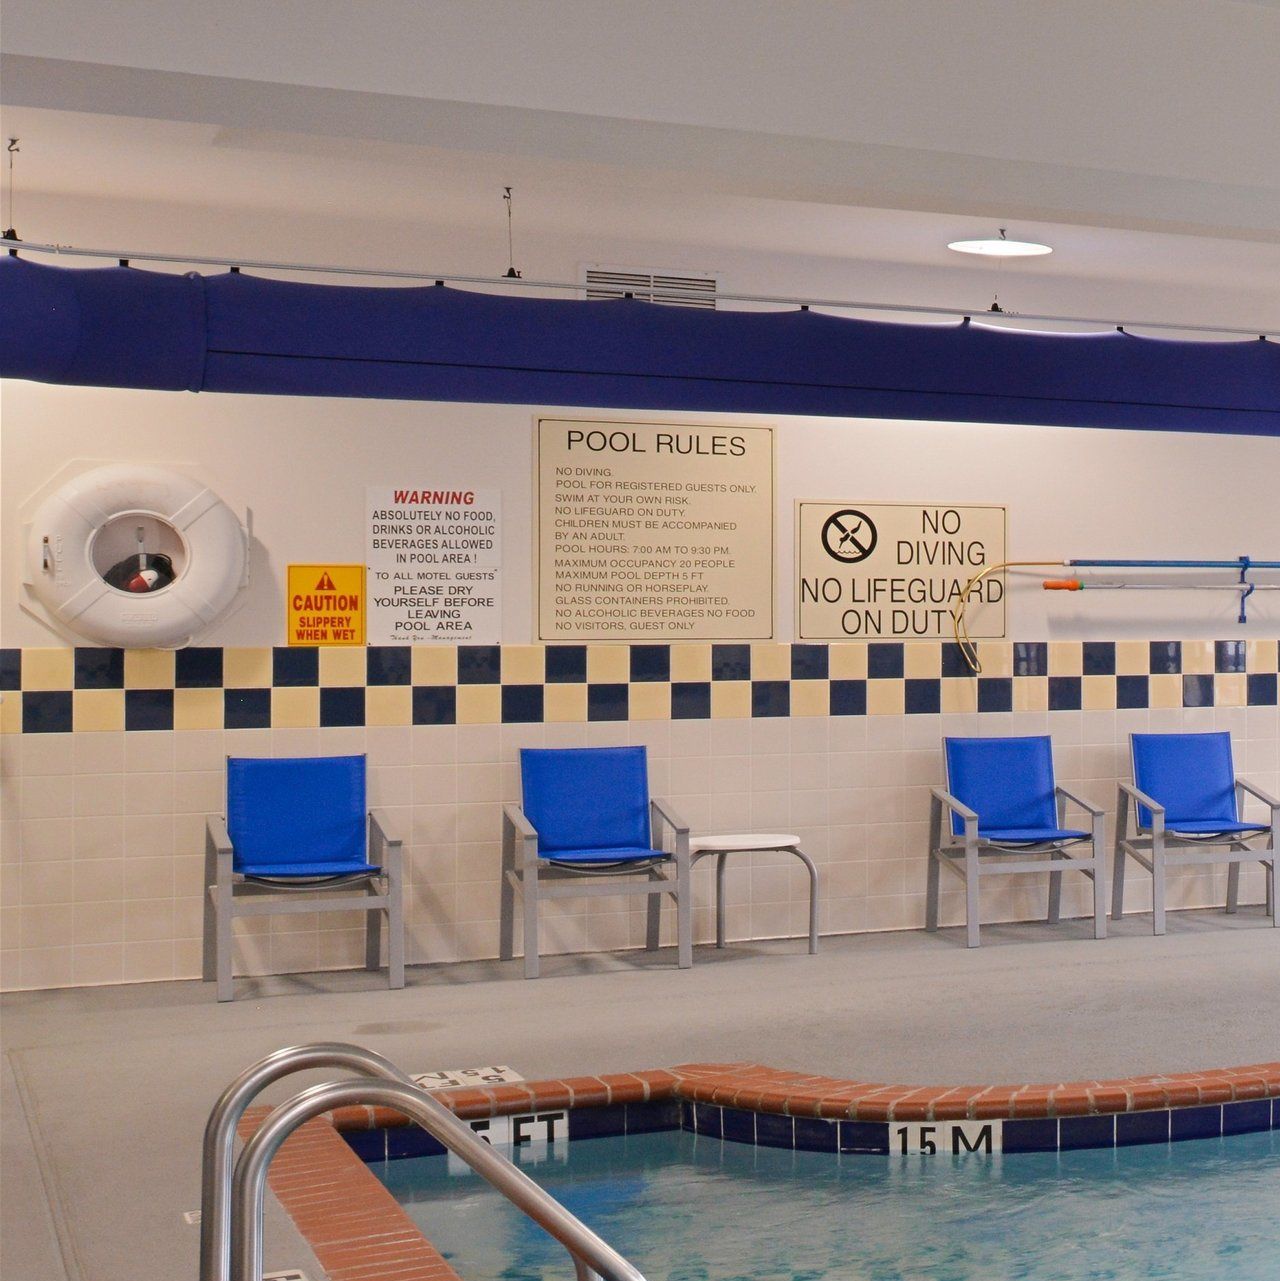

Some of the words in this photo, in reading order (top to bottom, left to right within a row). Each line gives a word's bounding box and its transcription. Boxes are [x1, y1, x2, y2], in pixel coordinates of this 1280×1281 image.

[568, 431, 646, 452] POOL
[656, 434, 745, 456] RULES
[556, 480, 586, 488] POOL
[590, 481, 611, 489] FOR
[616, 482, 682, 491] REGISTERED
[686, 484, 727, 492] GUESTS
[394, 491, 474, 504] WARNING
[555, 494, 584, 502] SWIM
[603, 495, 633, 503] YOUR
[636, 496, 662, 504] OWN
[373, 510, 441, 520] ABSOLUTELY
[446, 511, 460, 520] NO
[575, 507, 634, 515] LIFEGUARD
[638, 508, 653, 516] ON
[555, 520, 609, 528] CHILDREN
[612, 520, 641, 529] MUST
[646, 521, 659, 529] BE
[662, 521, 736, 530] ACCOMPANIED
[922, 510, 960, 534] NO
[373, 525, 412, 534] DRINKS
[416, 525, 431, 534] OR
[434, 525, 494, 535] ALCOHOLIC
[555, 532, 569, 540] BY
[572, 532, 587, 540] AN
[373, 539, 438, 548] BEVERAGES
[441, 540, 492, 549] ALLOWED
[555, 545, 585, 553] POOL
[655, 546, 671, 554] AM
[675, 546, 688, 554] TO
[691, 546, 710, 554] 9:30
[897, 541, 985, 565] DIVING
[397, 554, 406, 563] IN
[410, 554, 439, 563] POOL
[394, 586, 443, 595] PLEASE
[449, 586, 473, 595] DRY
[802, 578, 842, 603] NO
[852, 578, 1003, 603] LIFEGUARD
[293, 595, 358, 611] CAUTION
[374, 598, 439, 607] YOURSELF
[445, 598, 493, 607] BEFORE
[408, 610, 460, 619] LEAVING
[555, 609, 571, 617] NO
[575, 609, 637, 617] ALCOHOLIC
[641, 609, 704, 617] BEVERAGES
[707, 609, 722, 617] NO
[726, 609, 755, 617] FOOD
[299, 617, 351, 627] SLIPPERY
[395, 622, 430, 630] POOL
[437, 622, 472, 630] AREA
[842, 609, 881, 634] ON
[892, 610, 963, 634] DUTY
[296, 630, 327, 640] WHEN
[333, 630, 355, 640] WET
[952, 1125, 992, 1155] M
